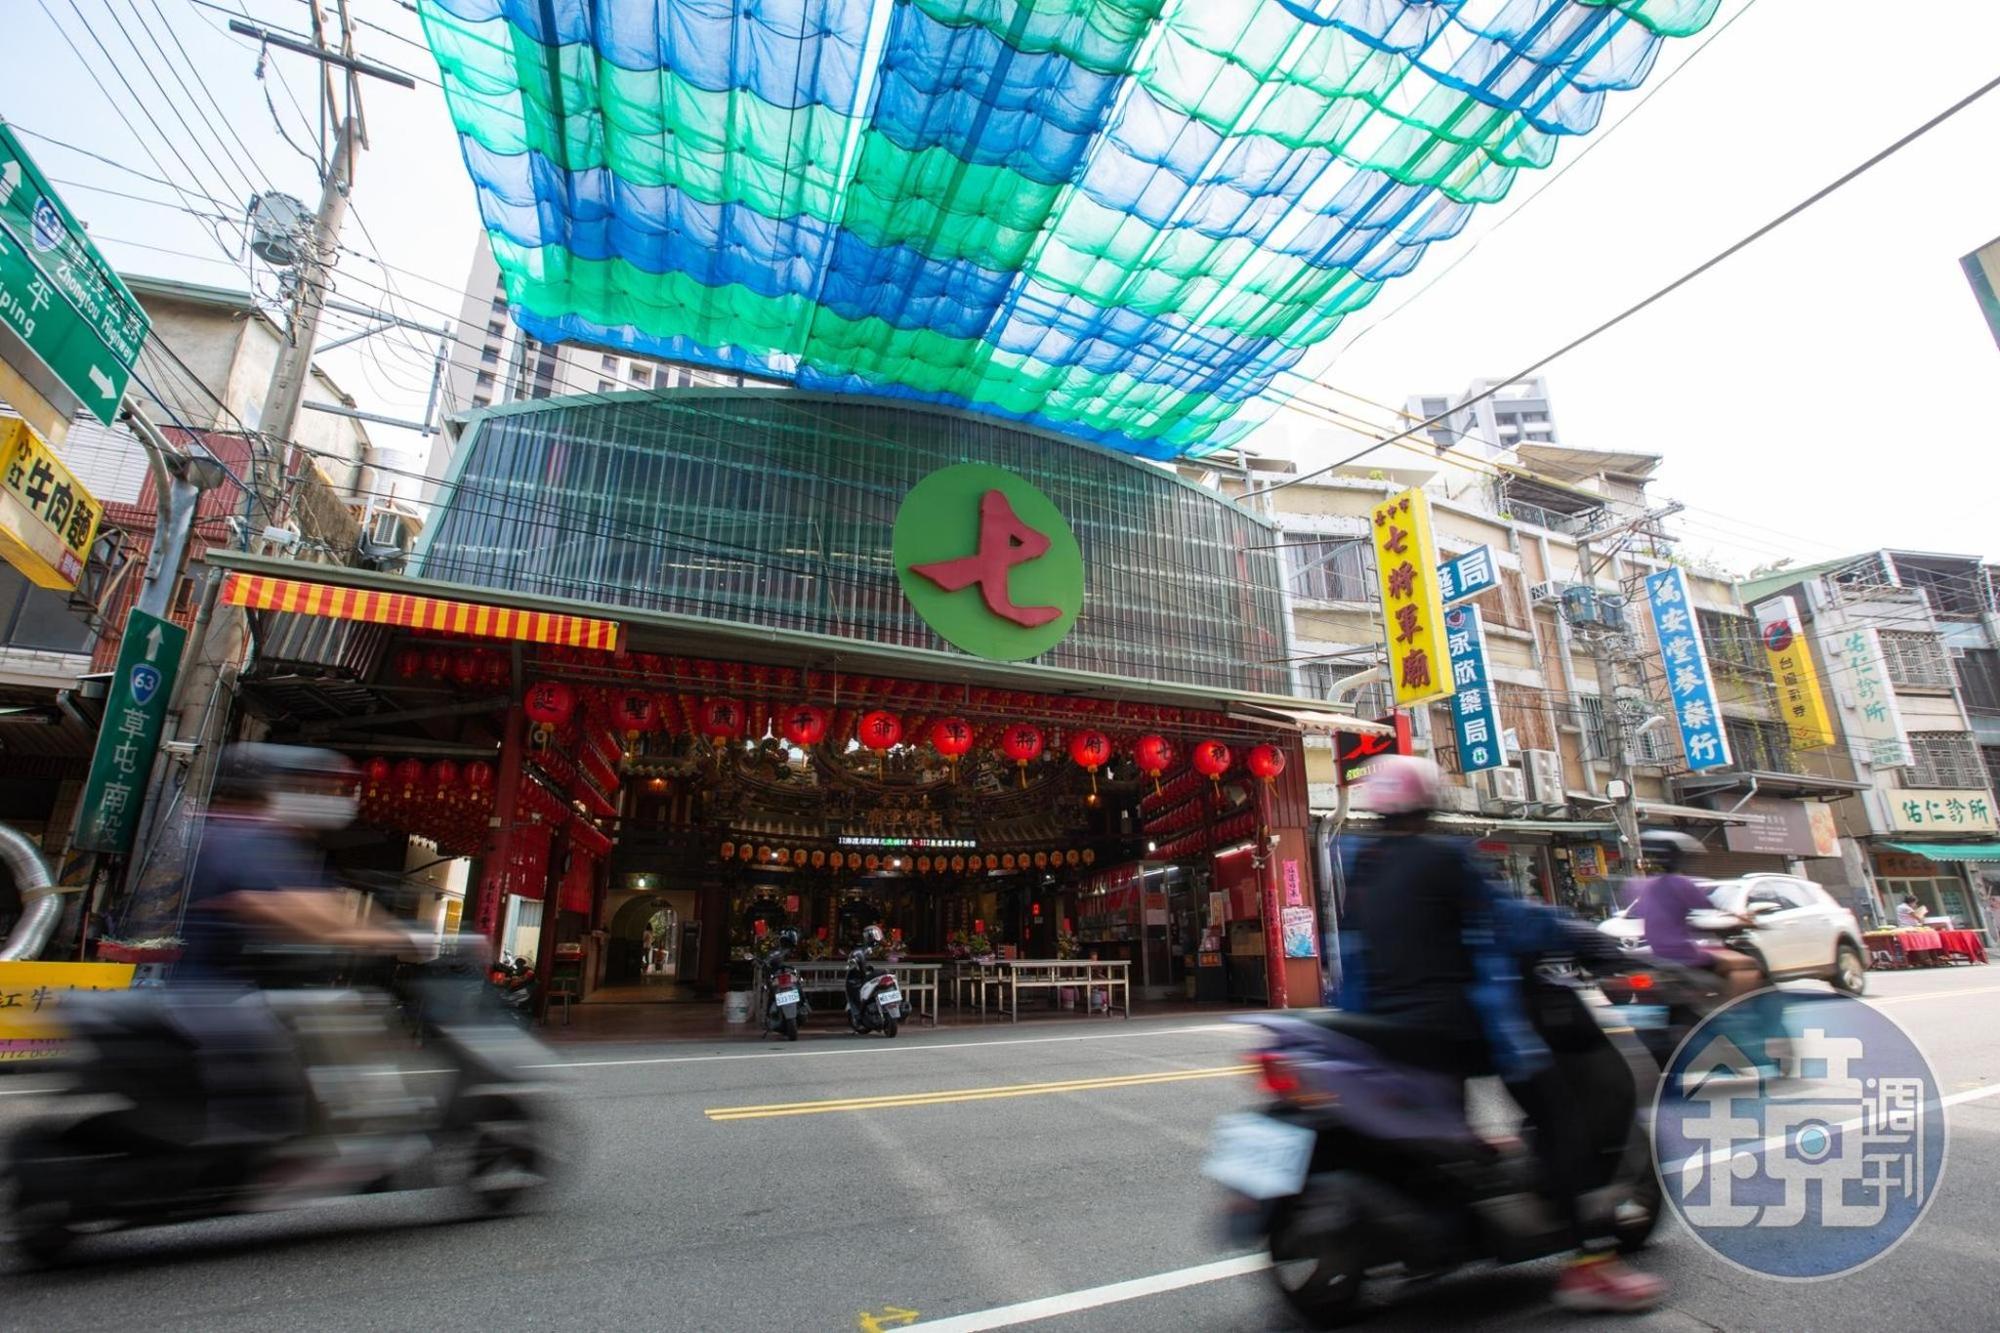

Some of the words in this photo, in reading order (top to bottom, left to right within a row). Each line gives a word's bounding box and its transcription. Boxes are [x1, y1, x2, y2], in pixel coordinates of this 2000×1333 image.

[56, 259, 100, 320] Zhongtou
[101, 315, 135, 365] Highway
[908, 489, 1063, 628] 七
[1383, 525, 1432, 689] 七將軍廟
[134, 673, 156, 691] 63
[1449, 631, 1489, 746] 永欣藥局
[1844, 632, 1886, 723] 佑仁診所
[1902, 798, 1989, 824] 佑仁診所
